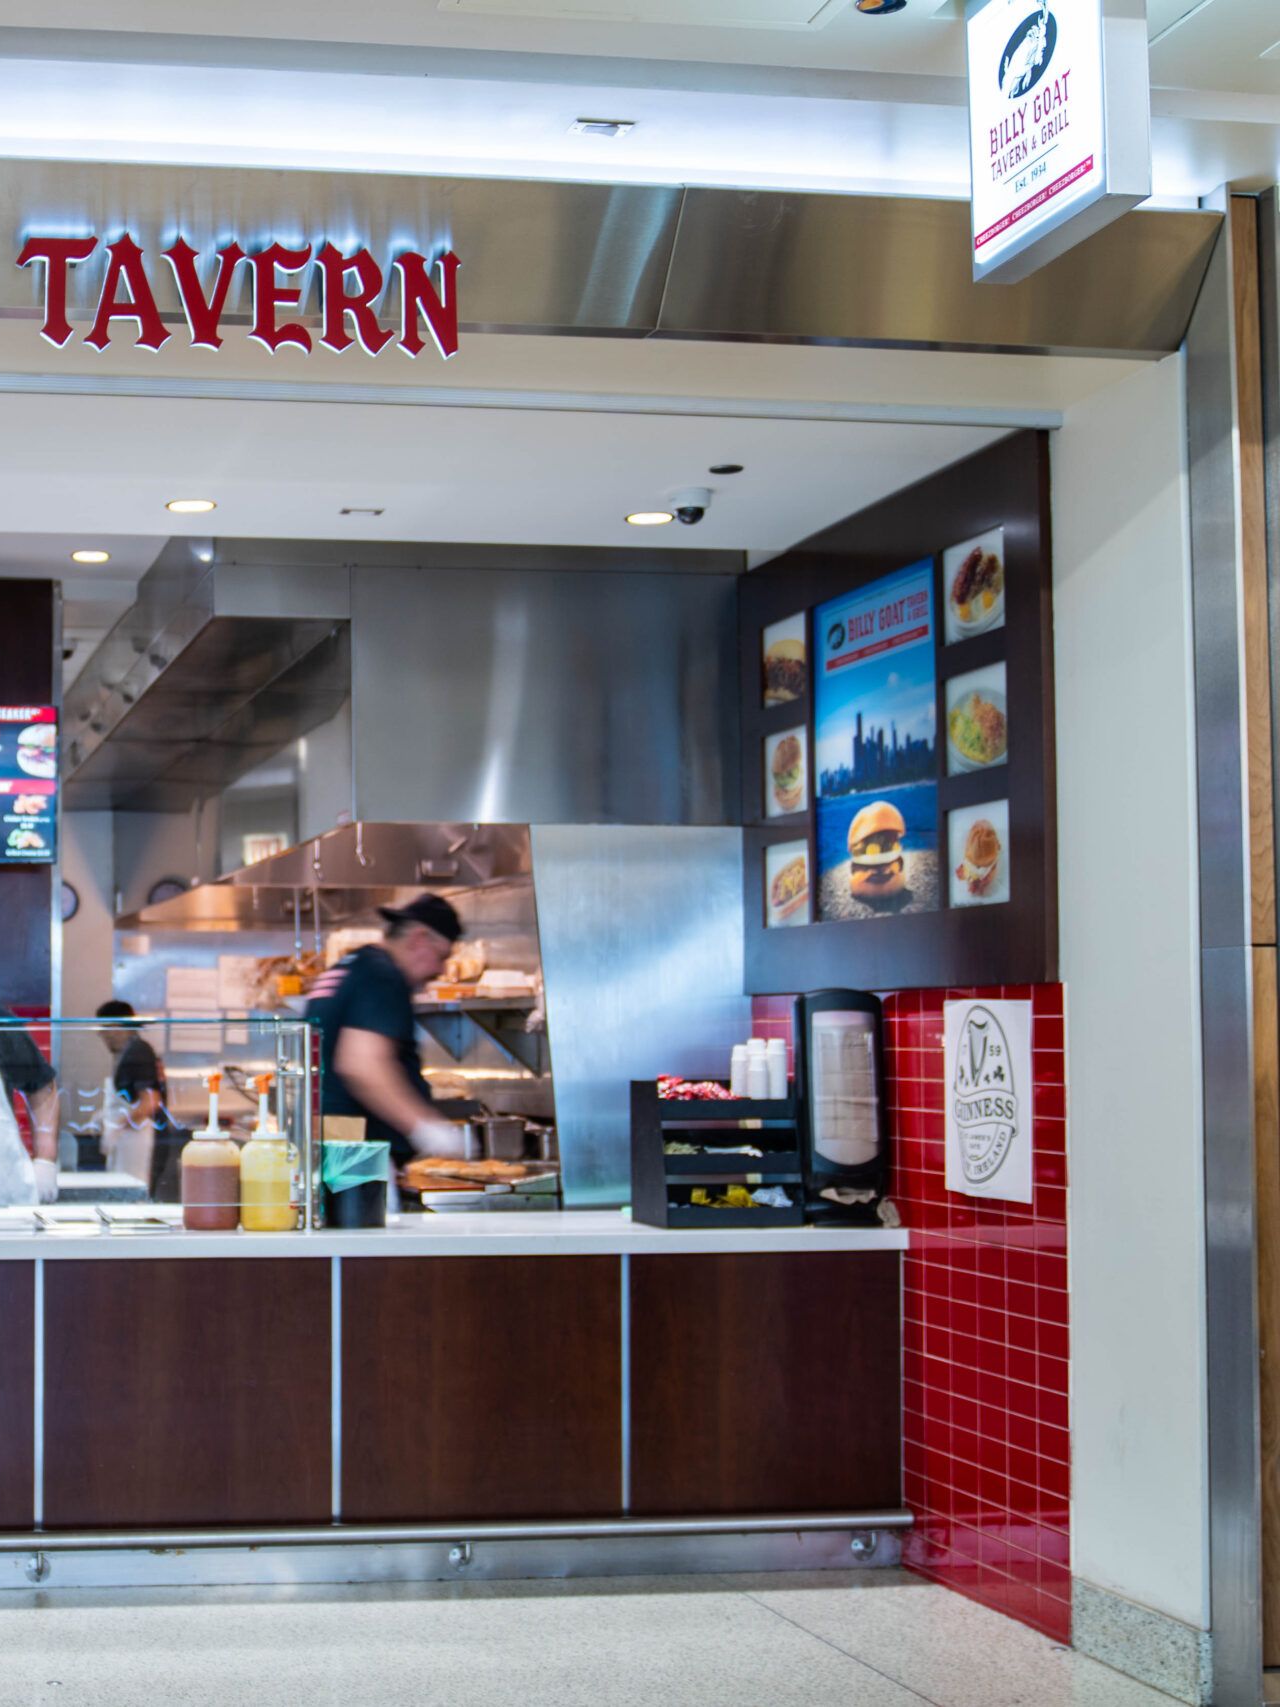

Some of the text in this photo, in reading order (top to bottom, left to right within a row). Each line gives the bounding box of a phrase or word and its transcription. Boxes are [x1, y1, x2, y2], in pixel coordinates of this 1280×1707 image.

[989, 69, 1071, 158] BILLY GOAT
[990, 109, 1070, 182] TAVERN & GRILL
[1031, 161, 1047, 181] 1934
[15, 231, 463, 361] TAVERN
[848, 610, 875, 641] BILLY
[879, 599, 905, 631] GOAT
[989, 1045, 1001, 1056] 59
[956, 1098, 1014, 1121] GUINNESS
[974, 1131, 1007, 1175] IRELAND
